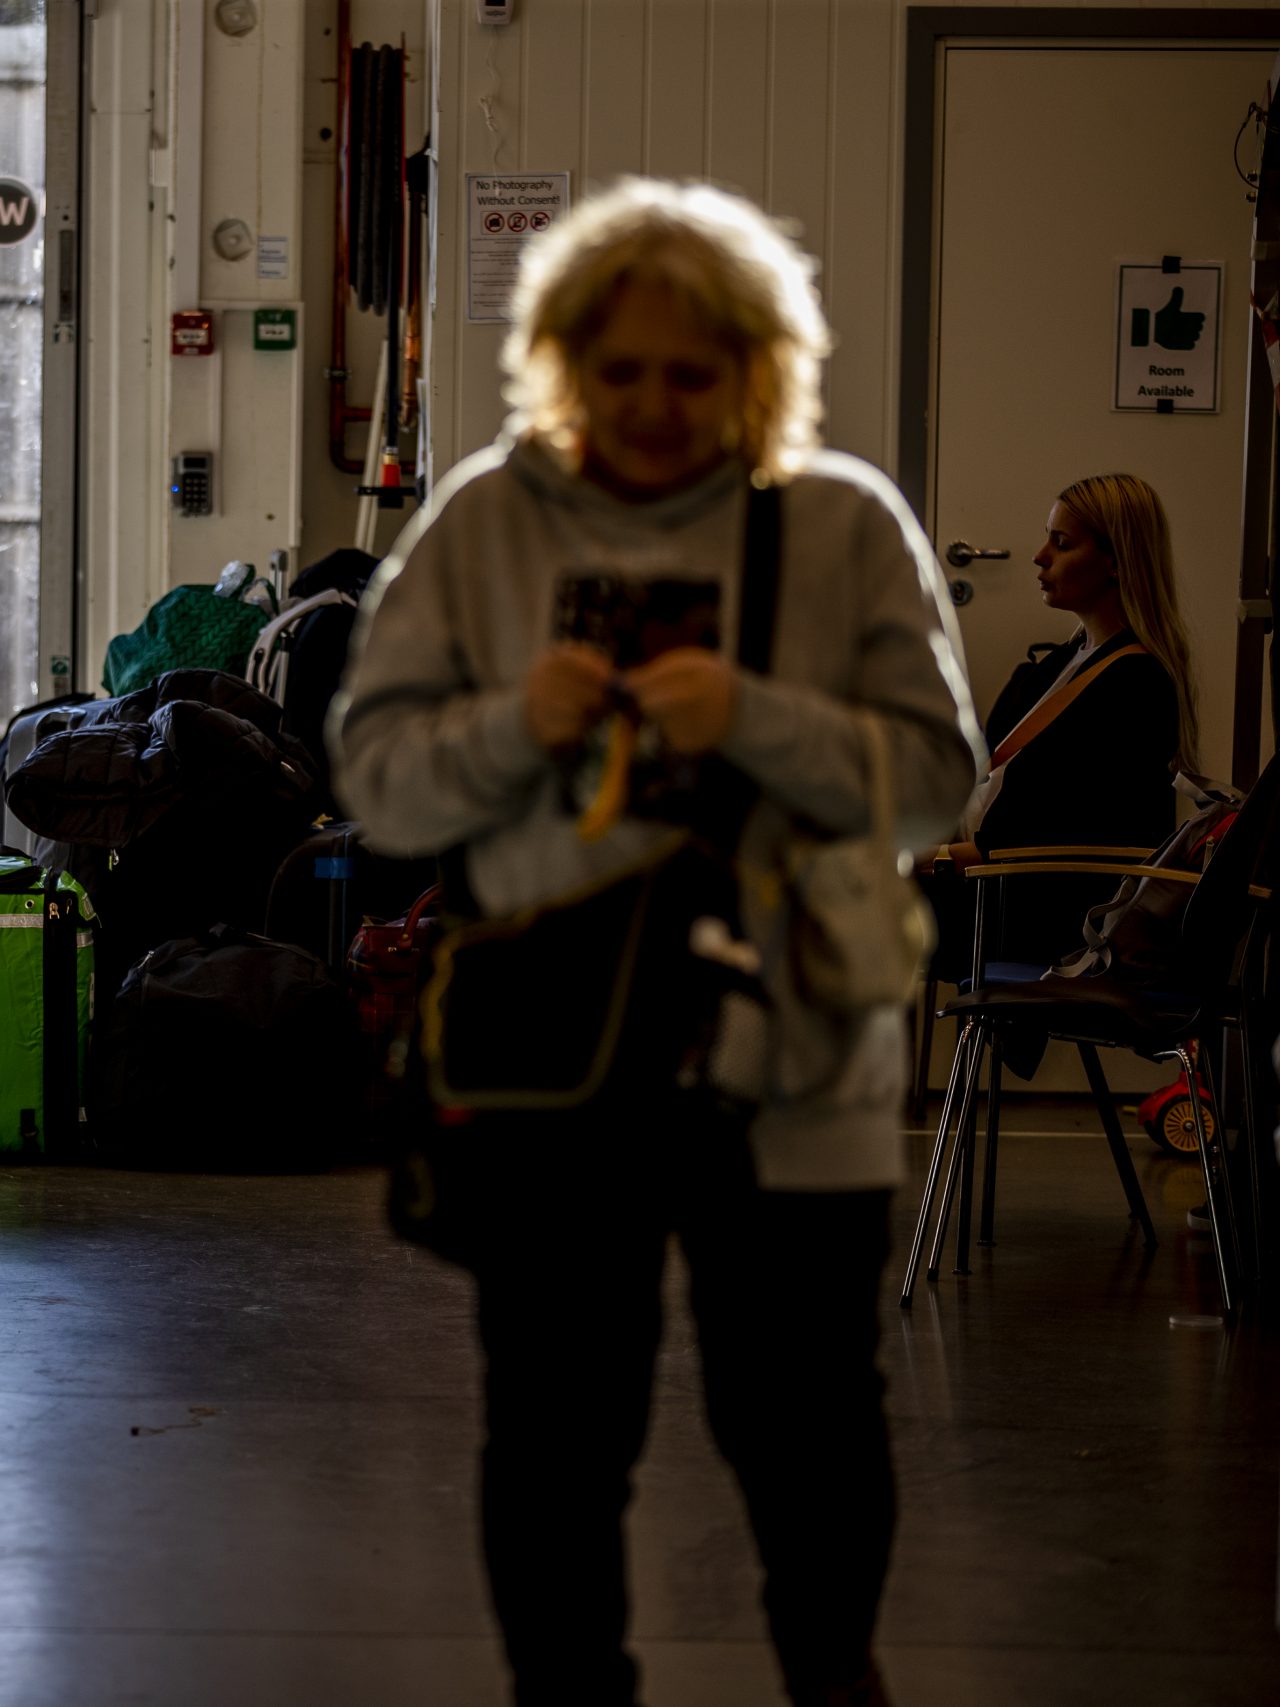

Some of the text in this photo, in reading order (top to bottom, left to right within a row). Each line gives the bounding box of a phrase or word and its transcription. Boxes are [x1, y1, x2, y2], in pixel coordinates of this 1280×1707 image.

[476, 181, 554, 191] No Photography
[478, 196, 560, 205] Without Consent!
[1149, 365, 1185, 376] Room
[1137, 385, 1195, 397] Available
